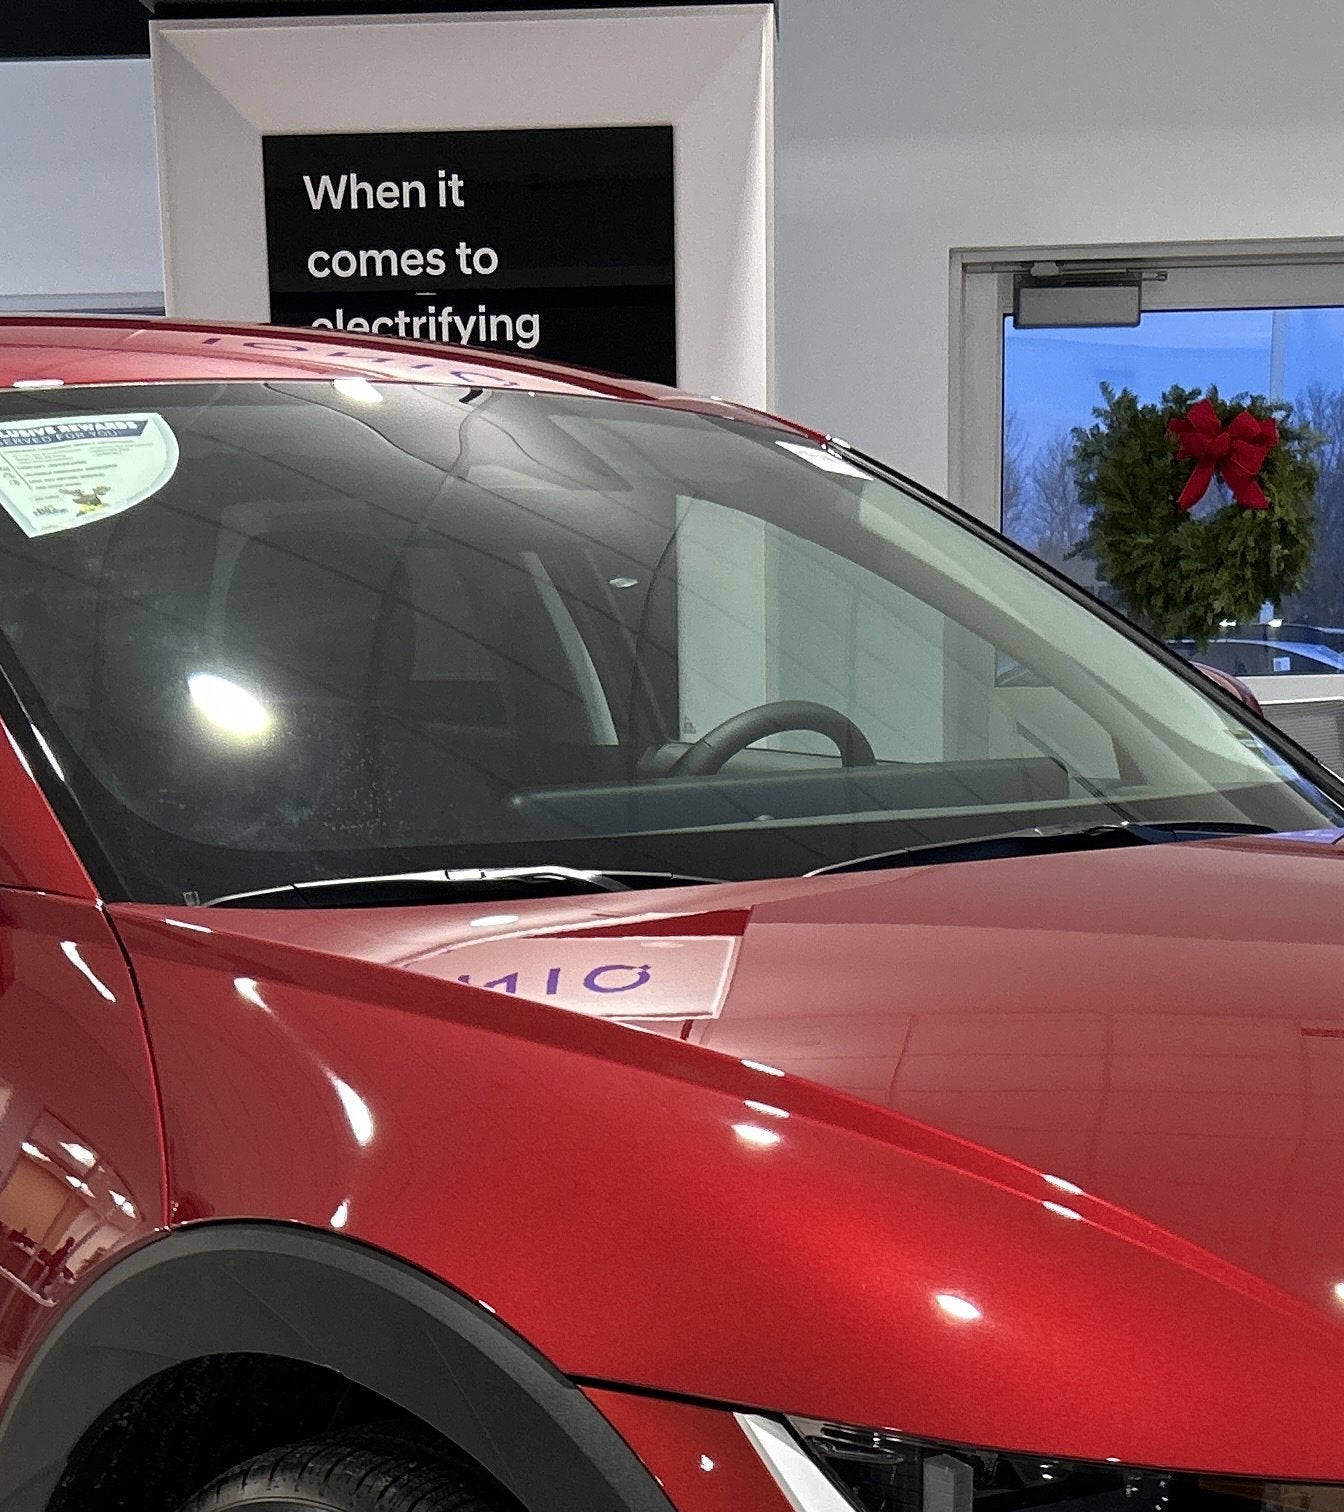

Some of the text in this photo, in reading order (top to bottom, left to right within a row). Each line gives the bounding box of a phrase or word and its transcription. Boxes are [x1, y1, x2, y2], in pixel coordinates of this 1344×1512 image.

[303, 170, 465, 210] When it
[307, 241, 499, 278] comes to
[56, 431, 85, 441] FOR
[90, 428, 118, 437] YOU
[57, 421, 138, 433] REWARDS
